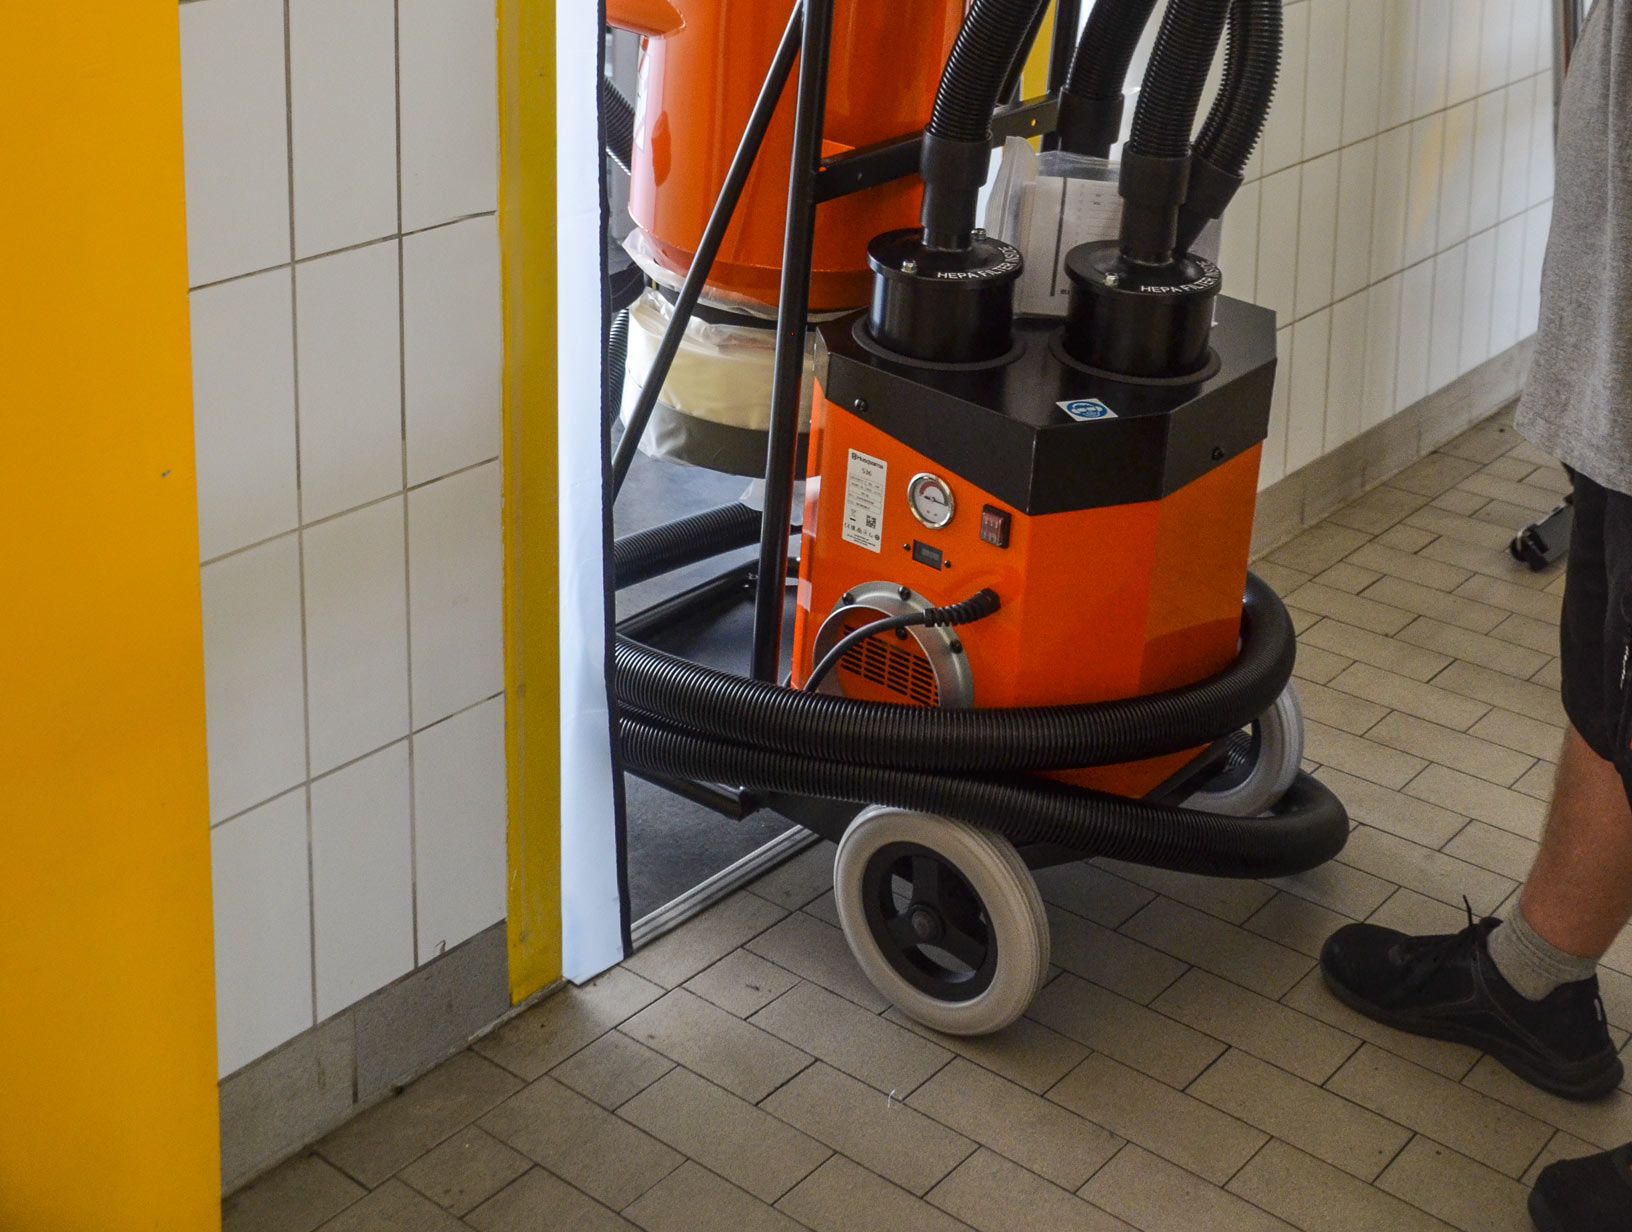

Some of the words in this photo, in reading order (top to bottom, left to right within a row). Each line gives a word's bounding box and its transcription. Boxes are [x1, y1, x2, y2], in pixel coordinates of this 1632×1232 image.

[937, 271, 979, 279] HEPA
[978, 262, 1017, 276] FILTER
[1140, 285, 1183, 293] HEPA
[1180, 276, 1219, 291] FILTER
